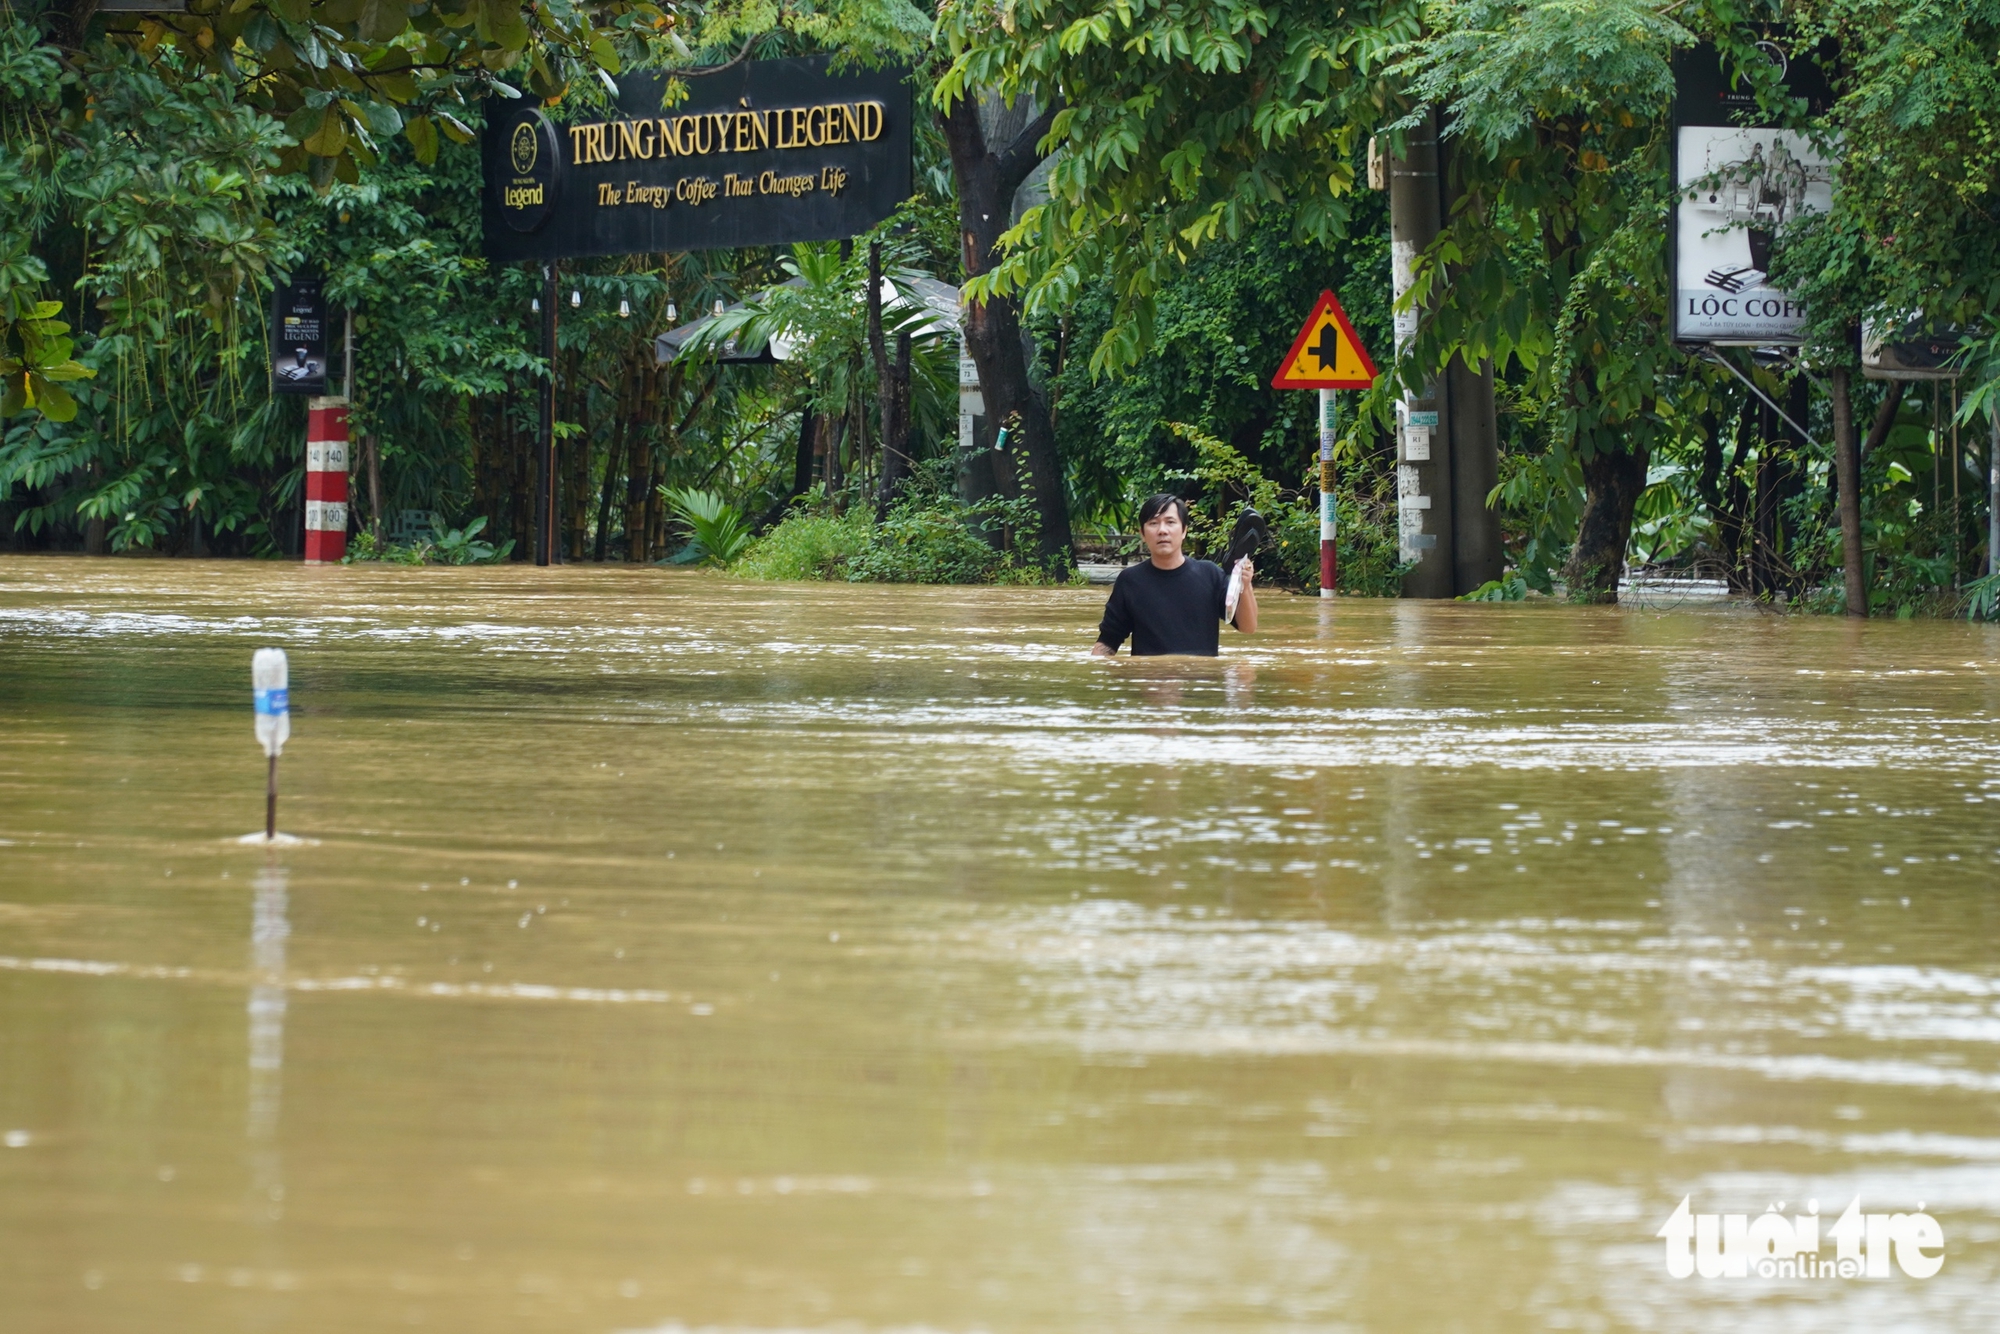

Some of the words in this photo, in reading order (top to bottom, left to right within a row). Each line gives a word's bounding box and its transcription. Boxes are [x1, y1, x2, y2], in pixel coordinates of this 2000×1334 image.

[569, 118, 655, 165] TRUNG
[774, 101, 883, 149] LEGEND
[505, 183, 543, 210] Legend
[598, 182, 621, 206] The
[626, 181, 670, 208] Energy
[676, 177, 716, 206] Coffee
[724, 173, 753, 197] That
[759, 170, 814, 197] Changes
[821, 167, 846, 197] Life
[1688, 293, 1738, 320] LỘC
[284, 333, 319, 341] LEGEND
[310, 450, 320, 461] 140
[326, 450, 342, 462] 140
[324, 509, 340, 522] 100
